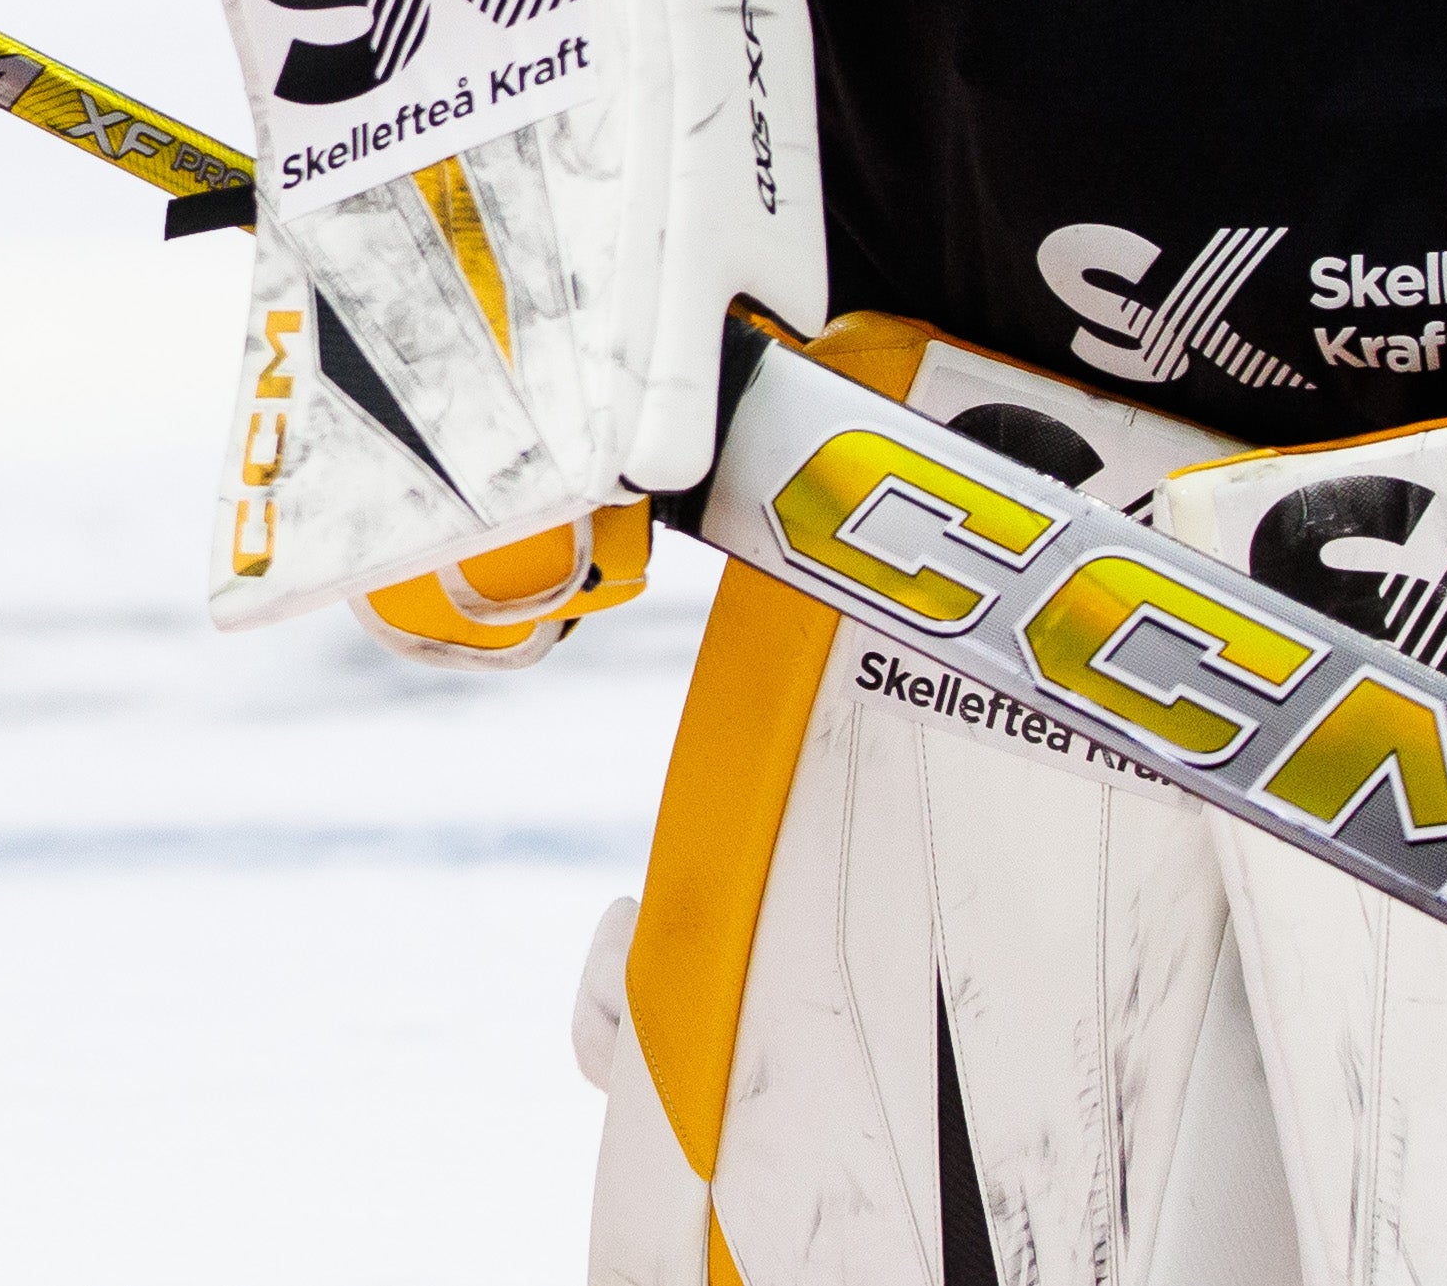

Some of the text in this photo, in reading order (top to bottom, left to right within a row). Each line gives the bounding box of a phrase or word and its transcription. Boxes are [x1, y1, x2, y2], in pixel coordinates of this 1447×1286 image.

[62, 89, 175, 159] XF
[282, 35, 591, 190] Skellefteå Kraft
[233, 310, 305, 578] CCM
